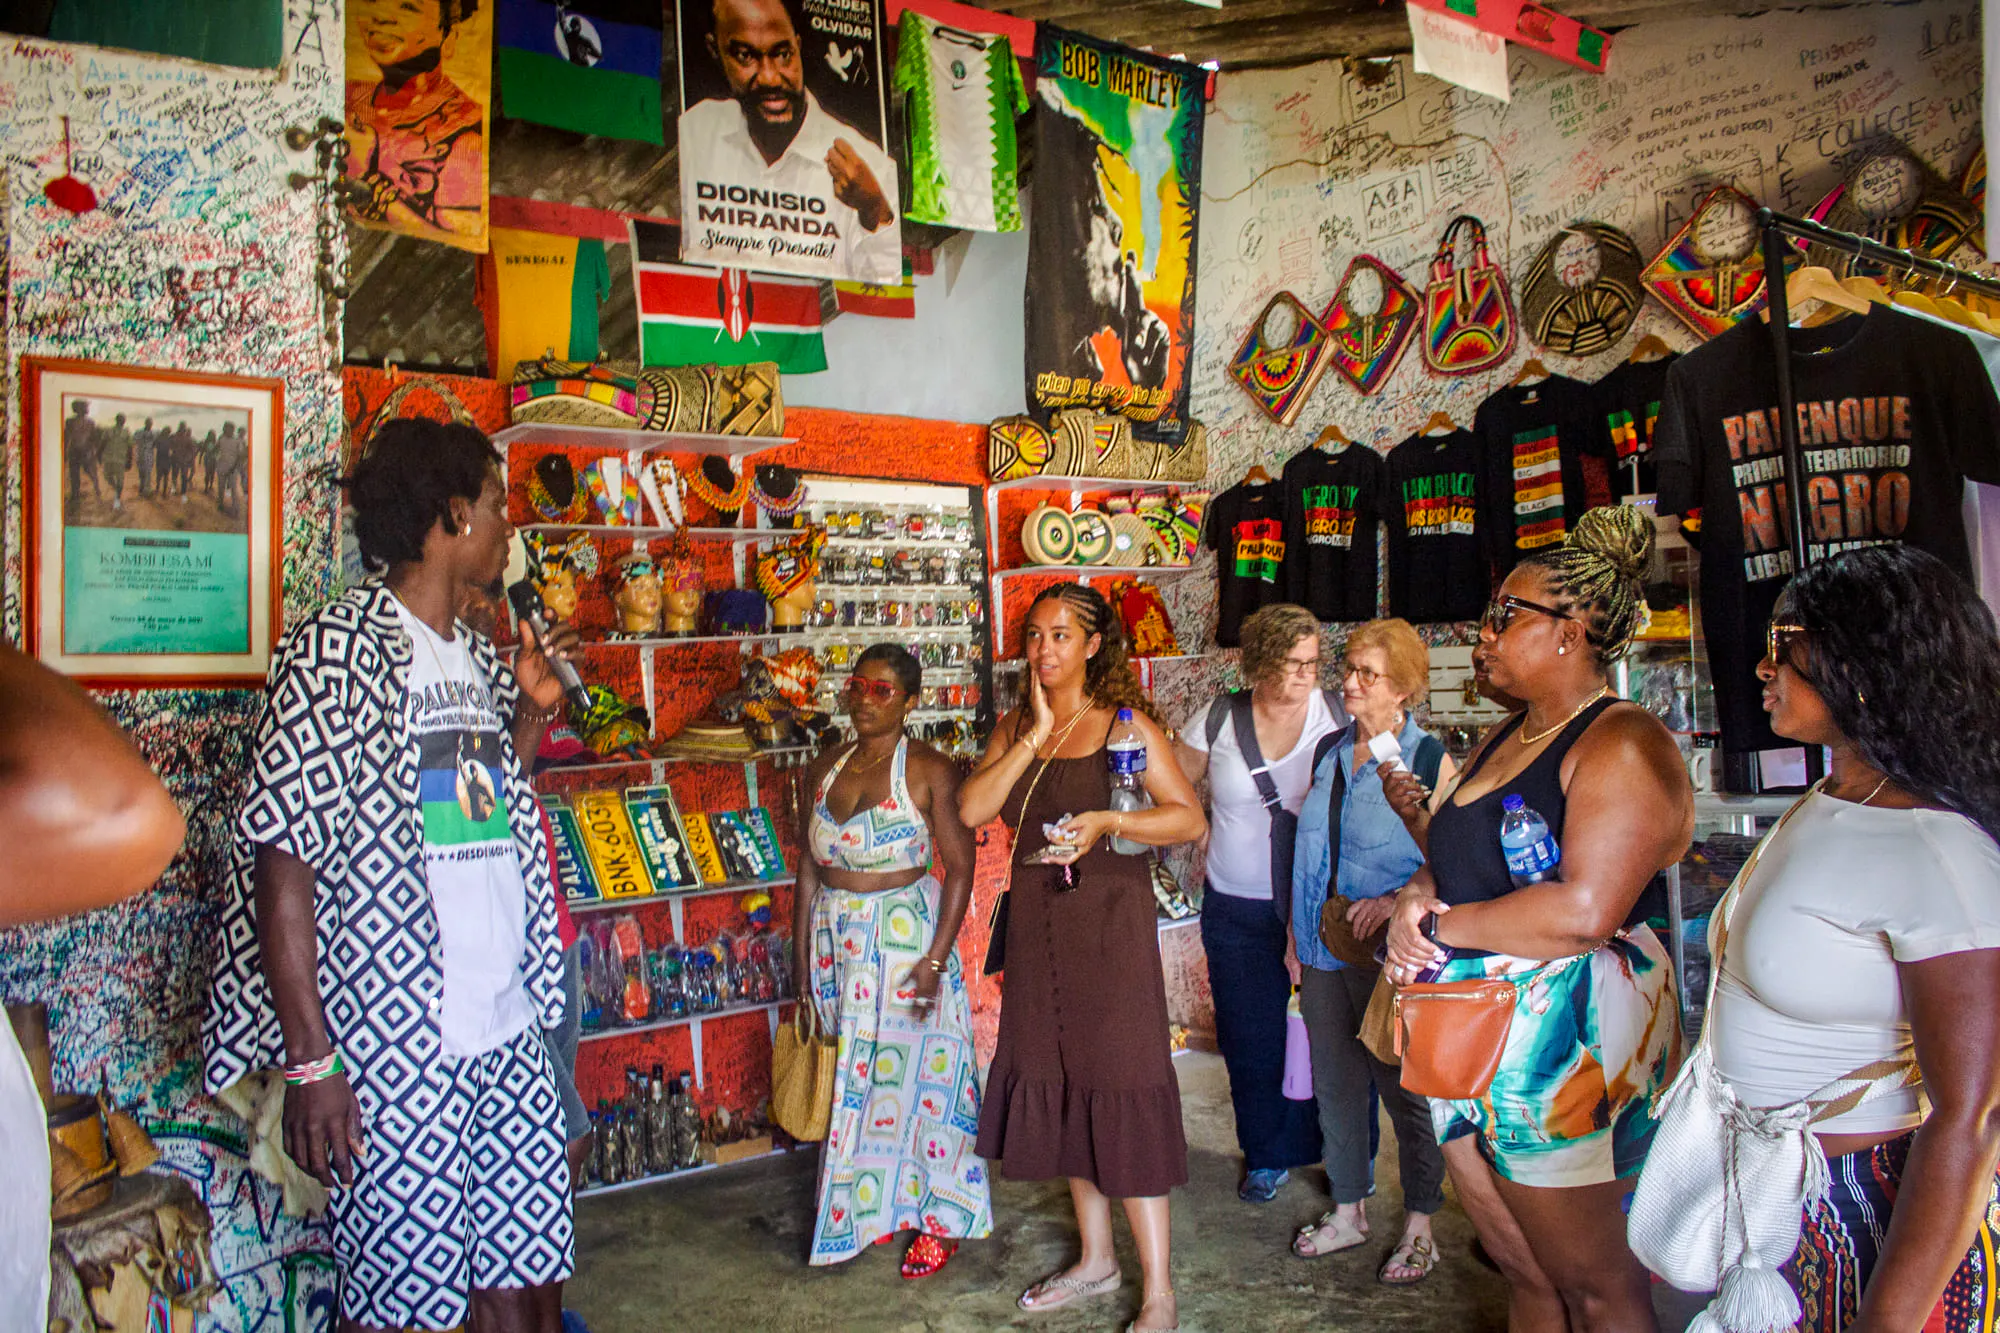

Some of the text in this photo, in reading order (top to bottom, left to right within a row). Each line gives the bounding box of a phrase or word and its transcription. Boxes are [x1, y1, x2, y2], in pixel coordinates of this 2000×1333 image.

[811, 16, 872, 40] OLVIDAR
[1062, 40, 1182, 110] BOB MARLEY
[1818, 95, 1928, 157] COLLEGE
[697, 181, 826, 214] DIONISIO
[698, 204, 841, 239] MIRANDA
[700, 227, 836, 259] Siempre Presente!
[1037, 371, 1071, 393] when
[1803, 444, 1911, 472] TERRITORIO
[1410, 477, 1432, 501] AM
[1519, 501, 1547, 513] BLACK
[1744, 549, 1795, 582] LIBR
